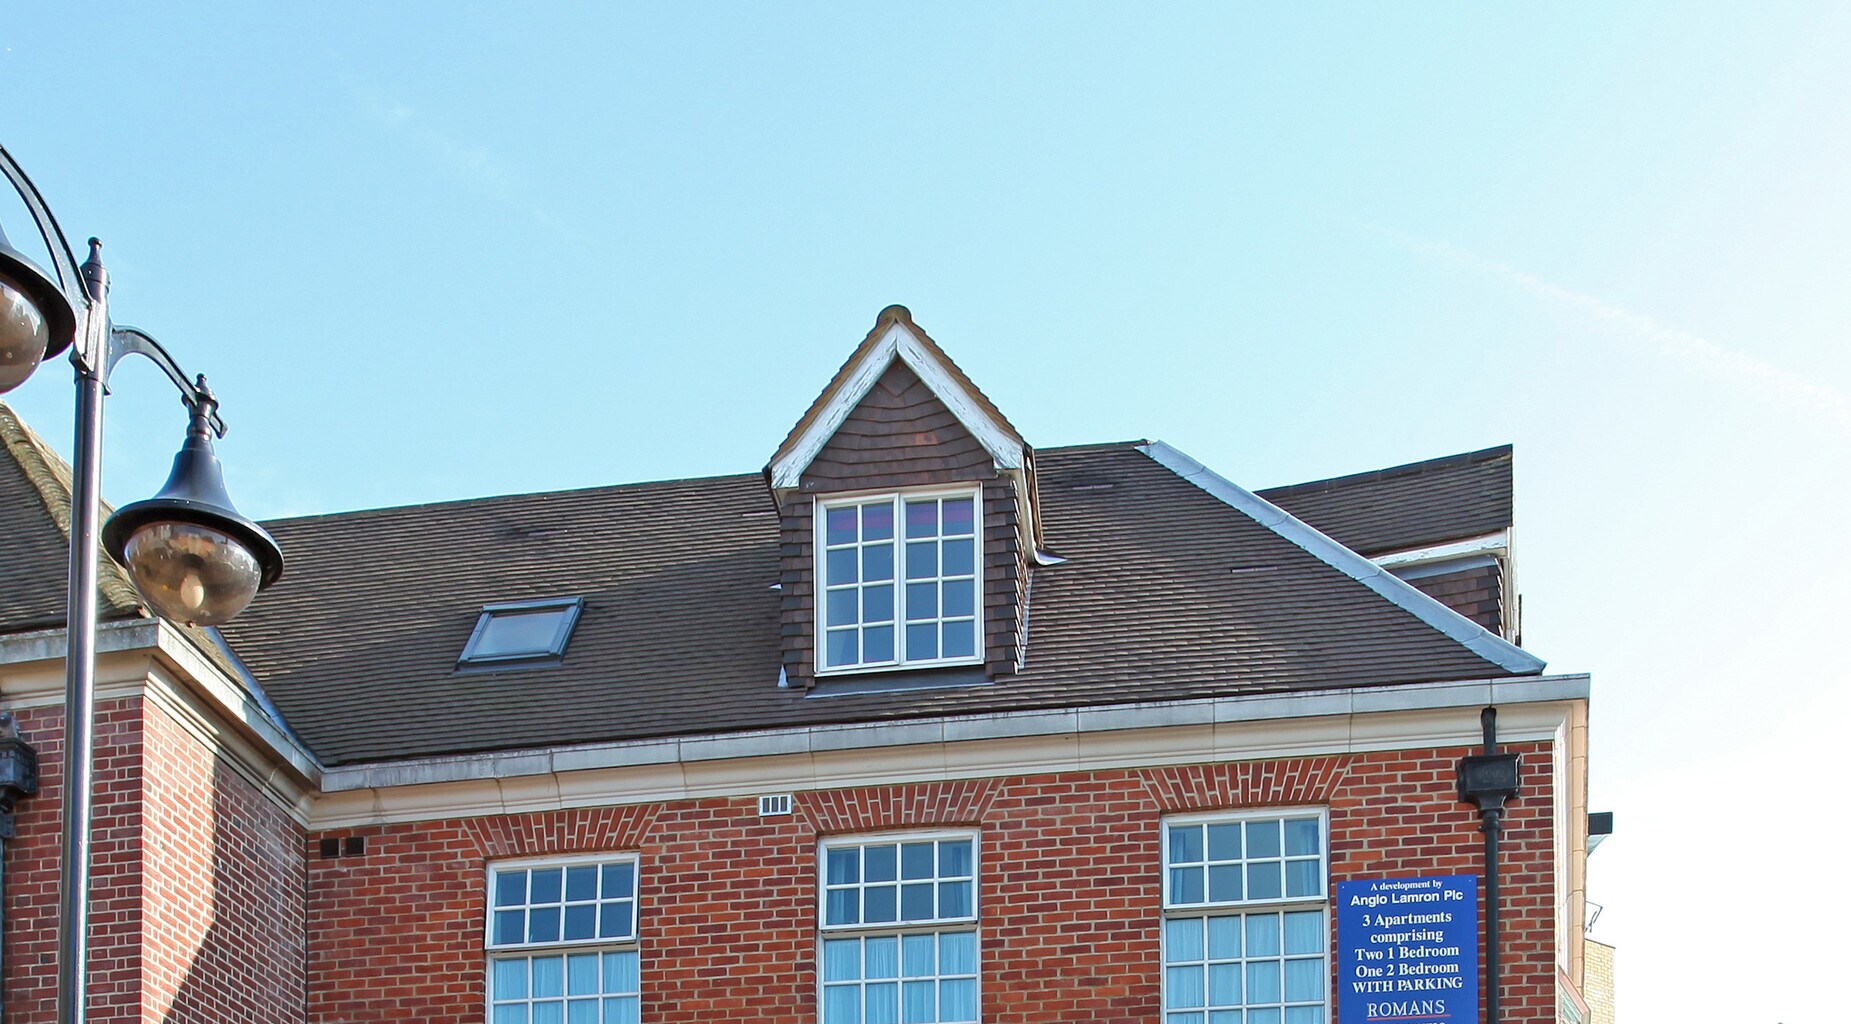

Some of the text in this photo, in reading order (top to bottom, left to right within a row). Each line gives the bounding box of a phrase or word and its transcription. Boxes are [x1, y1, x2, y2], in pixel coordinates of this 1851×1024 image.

[1370, 880, 1443, 891] A development by
[1350, 890, 1464, 908] Anglo Lamron Plc
[1362, 912, 1452, 928] 3 Apartments
[1370, 929, 1444, 945] comprising
[1355, 945, 1459, 960] Two 1 Bedroom
[1356, 962, 1459, 977] One 2 Bedroom
[1352, 977, 1463, 993] WITH PARKING
[1367, 1000, 1445, 1017] ROMANS
